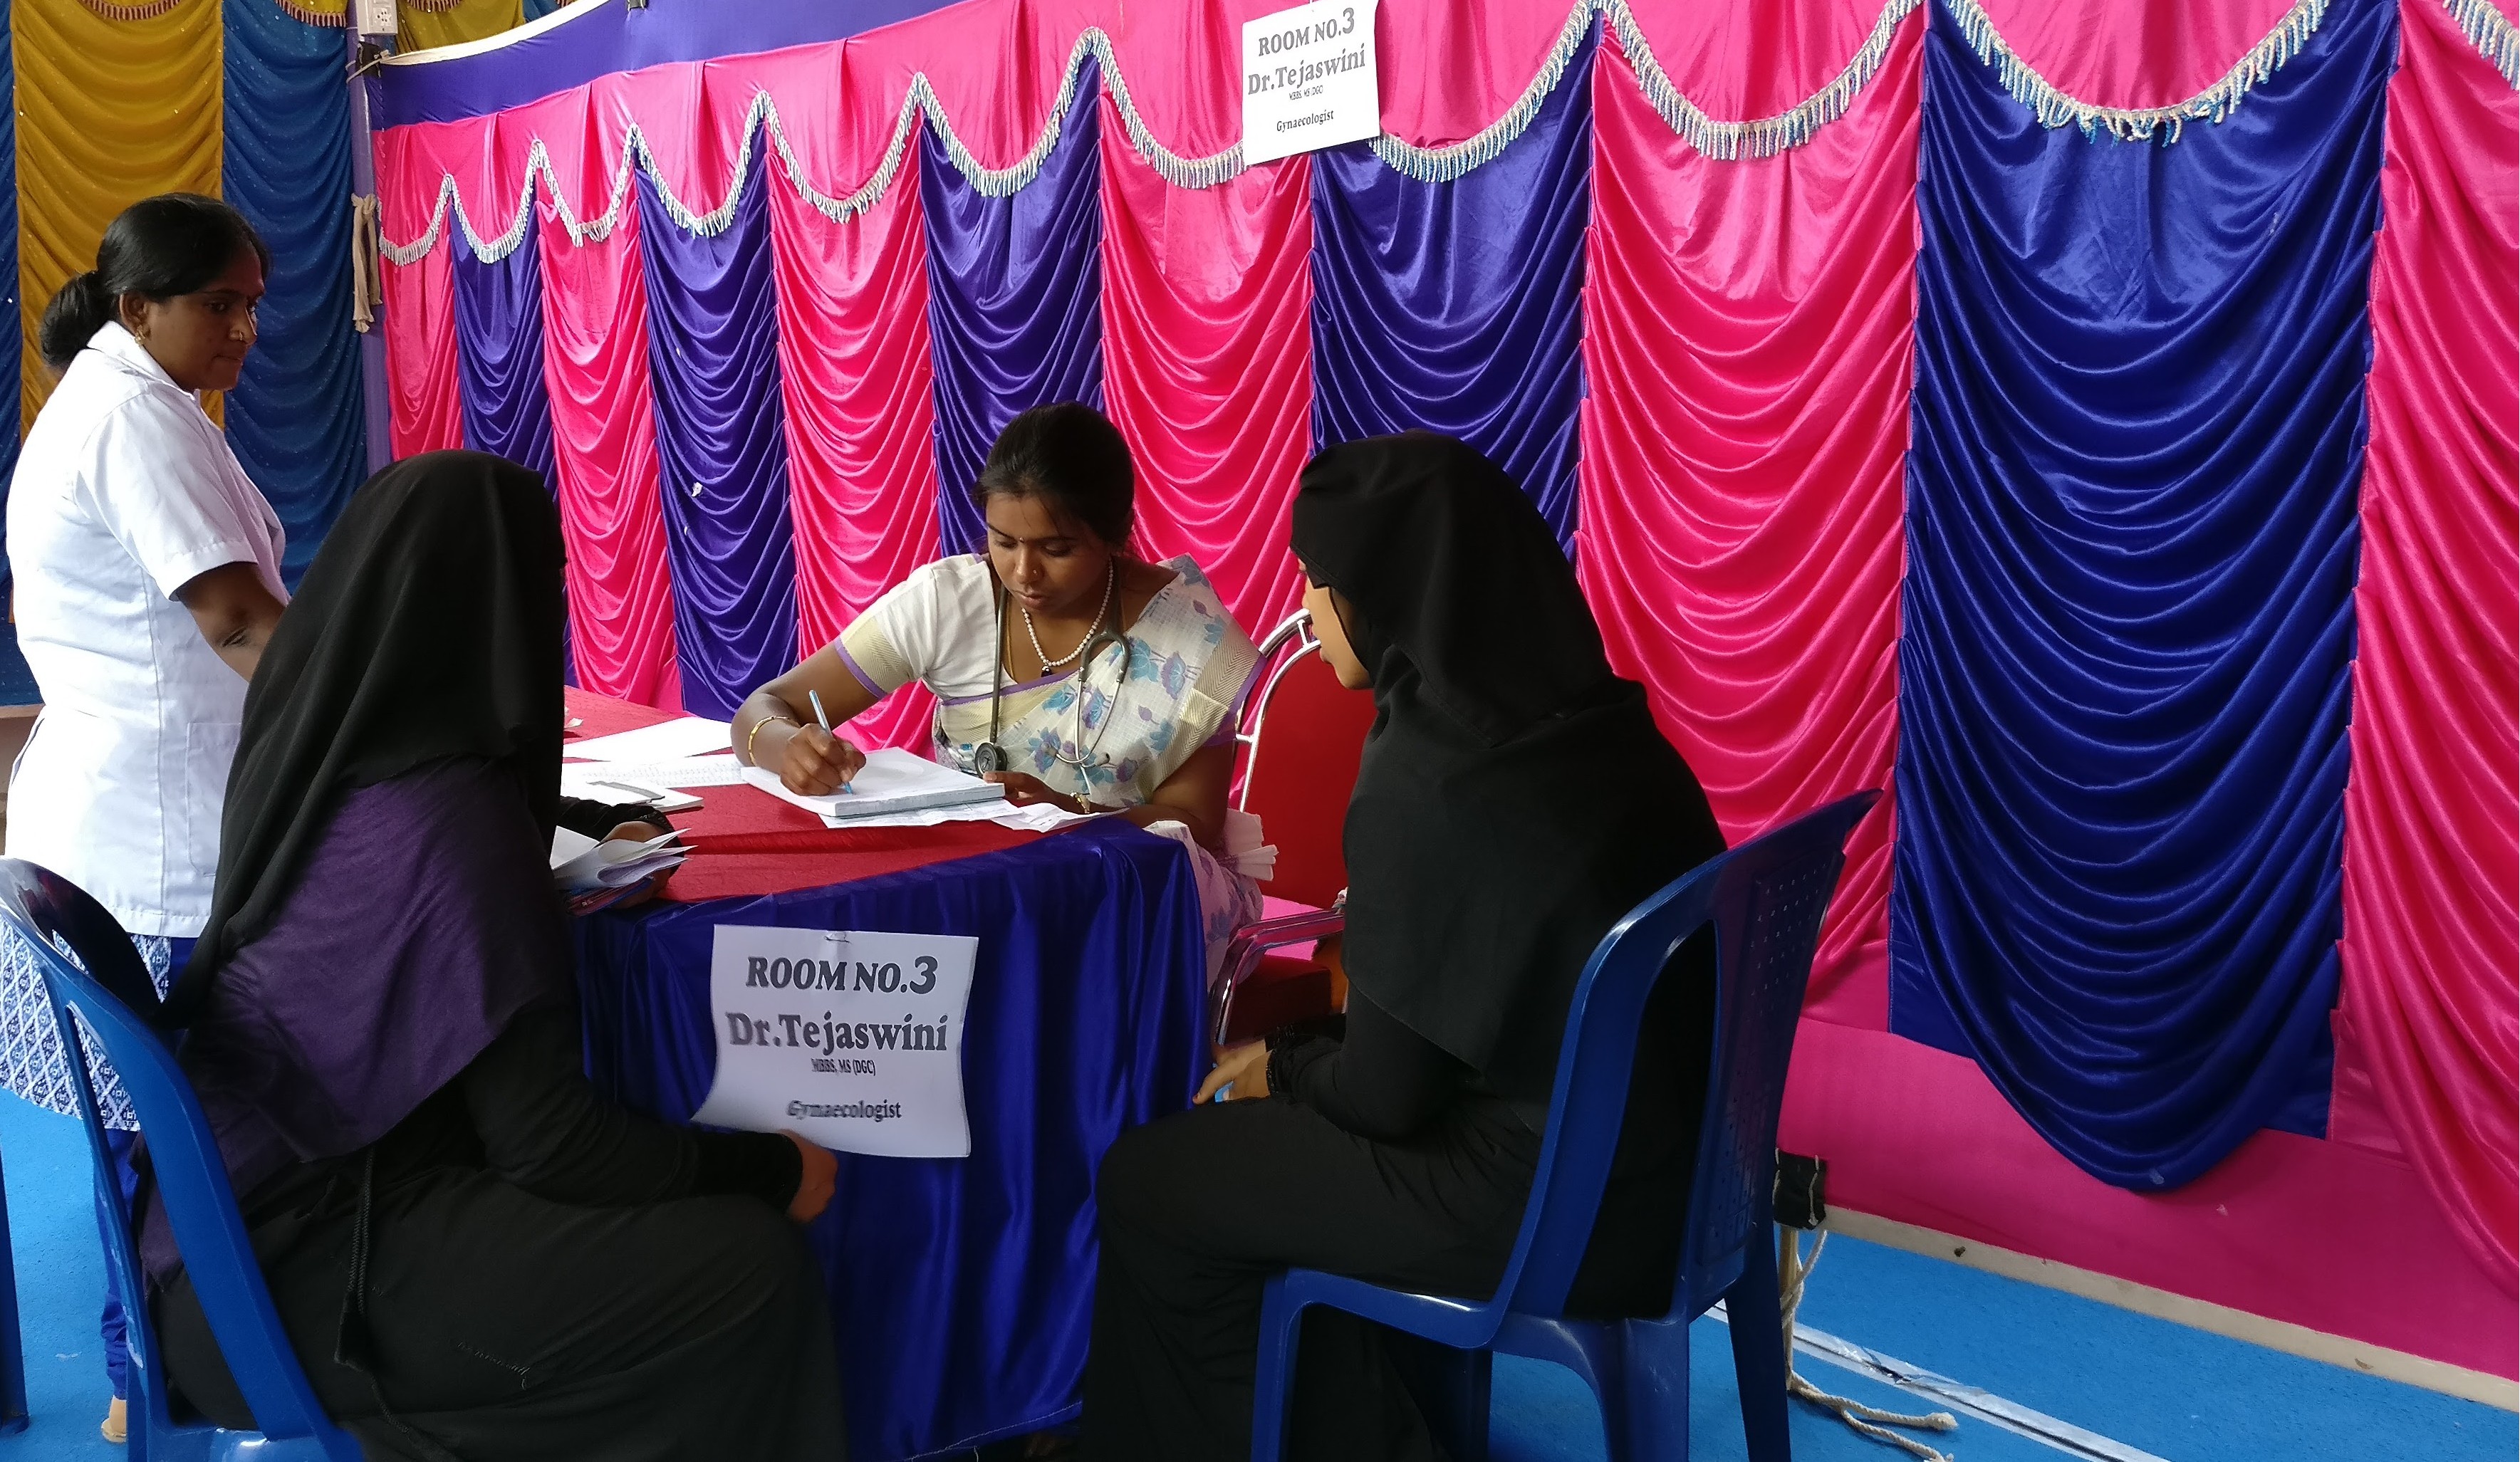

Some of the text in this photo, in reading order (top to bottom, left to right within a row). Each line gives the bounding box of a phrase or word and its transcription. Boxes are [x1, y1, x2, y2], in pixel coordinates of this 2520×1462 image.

[1258, 7, 1355, 56] ROOM NO.3
[1248, 43, 1365, 95] Dr.Tejaswini
[1276, 109, 1334, 133] Gynaecologist
[745, 956, 938, 994] ROOM NO.3
[725, 1011, 949, 1056] Dr.Tejaswini
[838, 1058, 851, 1073] MS
[786, 1099, 902, 1122] Gynaecologist
